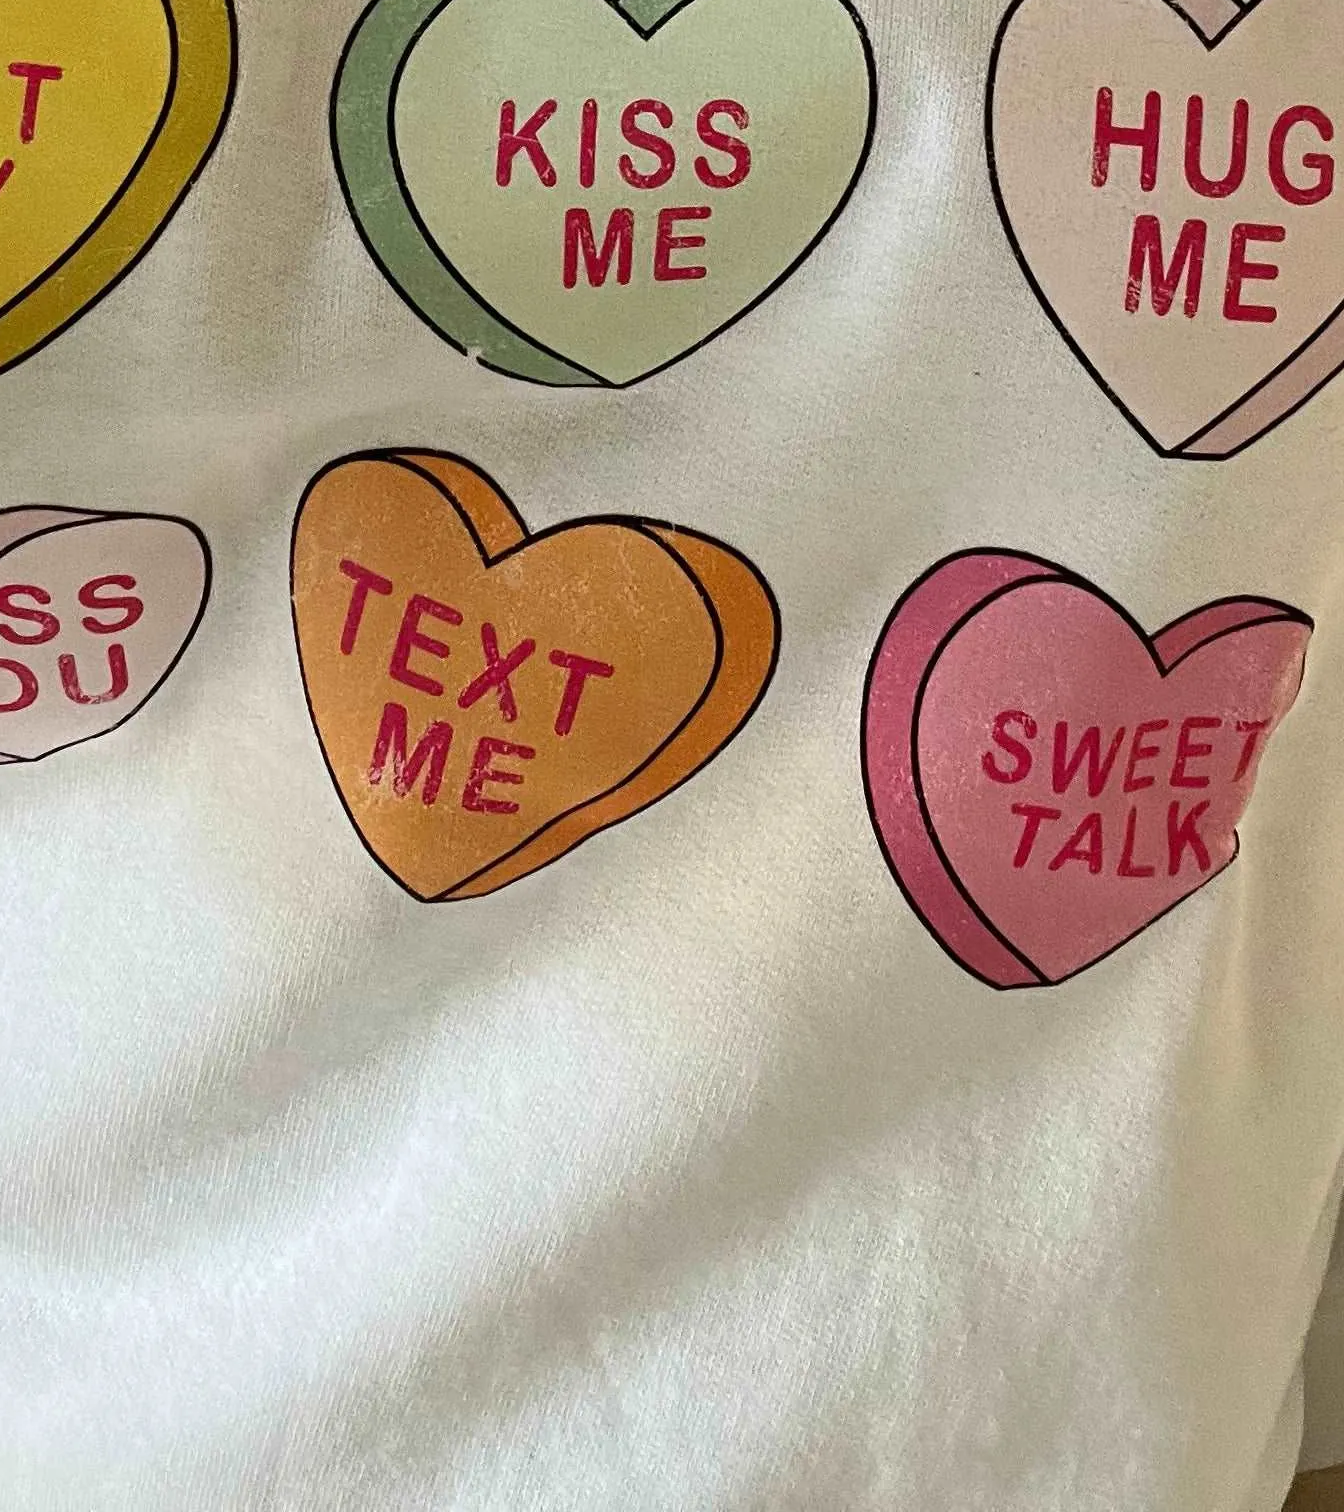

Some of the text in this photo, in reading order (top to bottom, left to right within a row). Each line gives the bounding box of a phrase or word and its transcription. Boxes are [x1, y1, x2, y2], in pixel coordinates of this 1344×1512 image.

[496, 99, 750, 189] KISS
[1093, 87, 1334, 206] HUG
[563, 206, 711, 289] ME
[1128, 215, 1286, 323] ME
[338, 559, 615, 737] TEXT
[368, 703, 536, 815] ME
[981, 709, 1273, 799] SWEET
[1010, 799, 1212, 879] TALK
